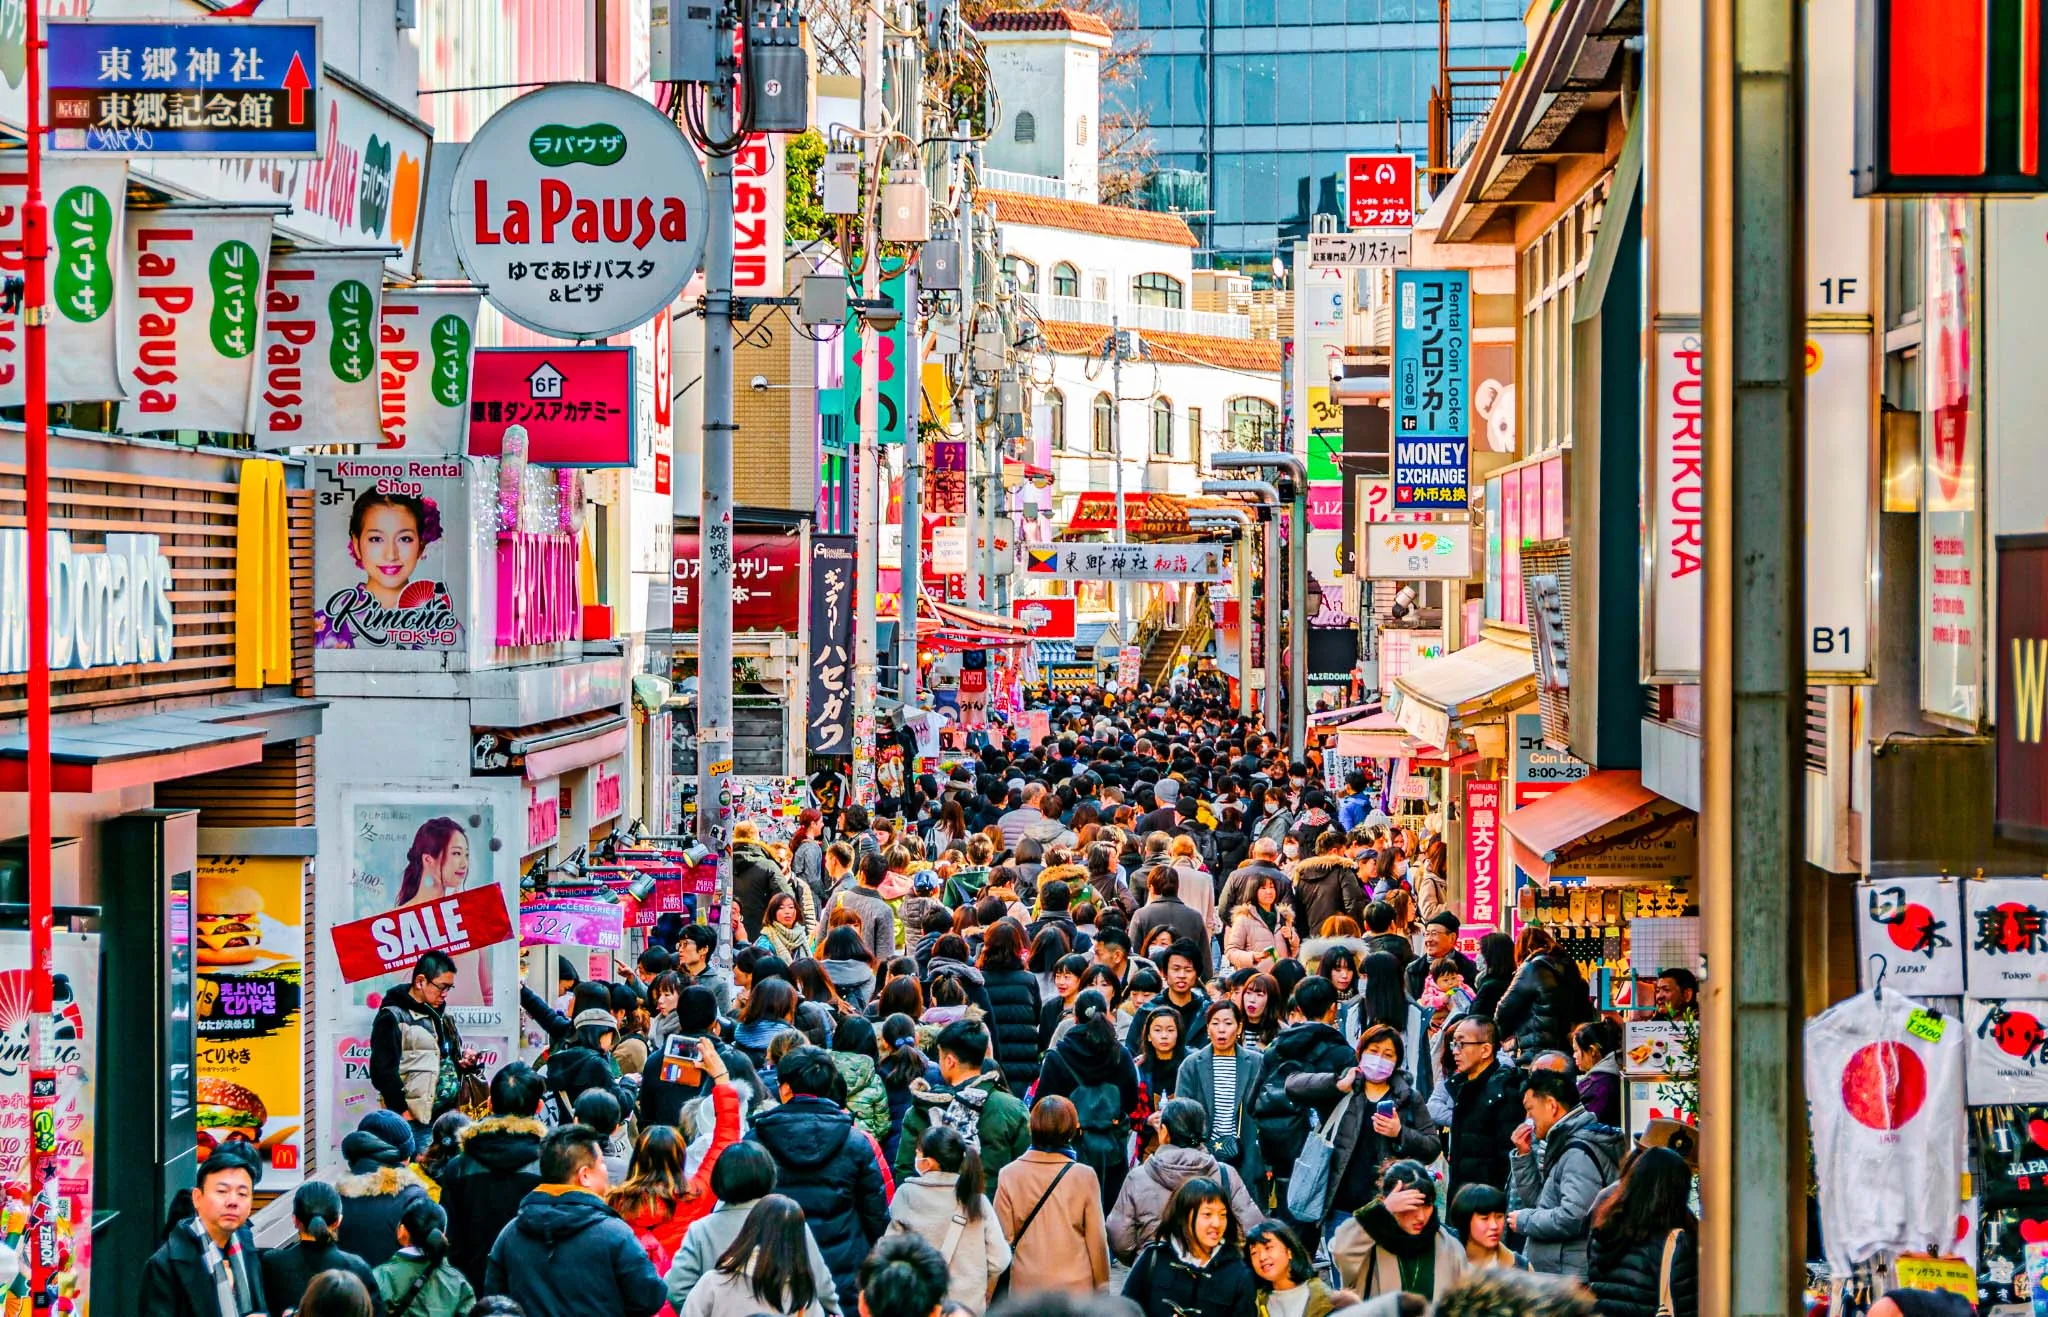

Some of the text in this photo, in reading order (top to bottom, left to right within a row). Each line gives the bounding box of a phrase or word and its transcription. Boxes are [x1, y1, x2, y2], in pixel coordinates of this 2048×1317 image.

[97, 47, 265, 82] 東郷神社
[97, 92, 273, 128] 東郷記念館
[533, 135, 622, 154] ラパウザ
[474, 179, 530, 245] La
[540, 178, 687, 250] Pausa
[1363, 209, 1411, 224] アガサ
[70, 191, 97, 322] ラパウザ
[1348, 242, 1408, 264] クリスティー
[508, 259, 655, 281] ゆであげパスタ
[224, 246, 246, 356] ラパウザ
[550, 284, 604, 302] &ピザ
[1819, 278, 1857, 305] 1F
[133, 228, 193, 413] La Pausa
[341, 285, 363, 379] ラパウザ
[262, 270, 316, 432] La Pausa
[443, 319, 460, 403] ラパウザ
[1422, 283, 1444, 431] コインロッカー
[1449, 282, 1462, 432] Rental Coin Locker
[535, 377, 558, 391] 6F
[377, 351, 419, 449] Pausa
[1402, 418, 1416, 430] 1F
[1397, 443, 1465, 465] MONEY
[1671, 350, 1702, 579] PURIKURA
[337, 462, 463, 477] Kimono Rental
[1397, 468, 1465, 485] EXCHANGE
[320, 492, 344, 505] 3F
[376, 479, 422, 495] Shop
[326, 587, 456, 645] Kimono
[387, 630, 455, 644] TOKYO
[1813, 627, 1850, 654] B1
[811, 567, 849, 751] ギャラリー ハセガワ
[1530, 753, 1557, 764] Coin
[1472, 810, 1494, 921] 最大プリクラ店
[371, 898, 469, 961] SALE
[532, 916, 572, 939] 324
[1974, 905, 2048, 955] 東京
[1895, 965, 1927, 974] JAPAN
[2002, 971, 2032, 980] Tokyo
[221, 996, 276, 1015] てりやき
